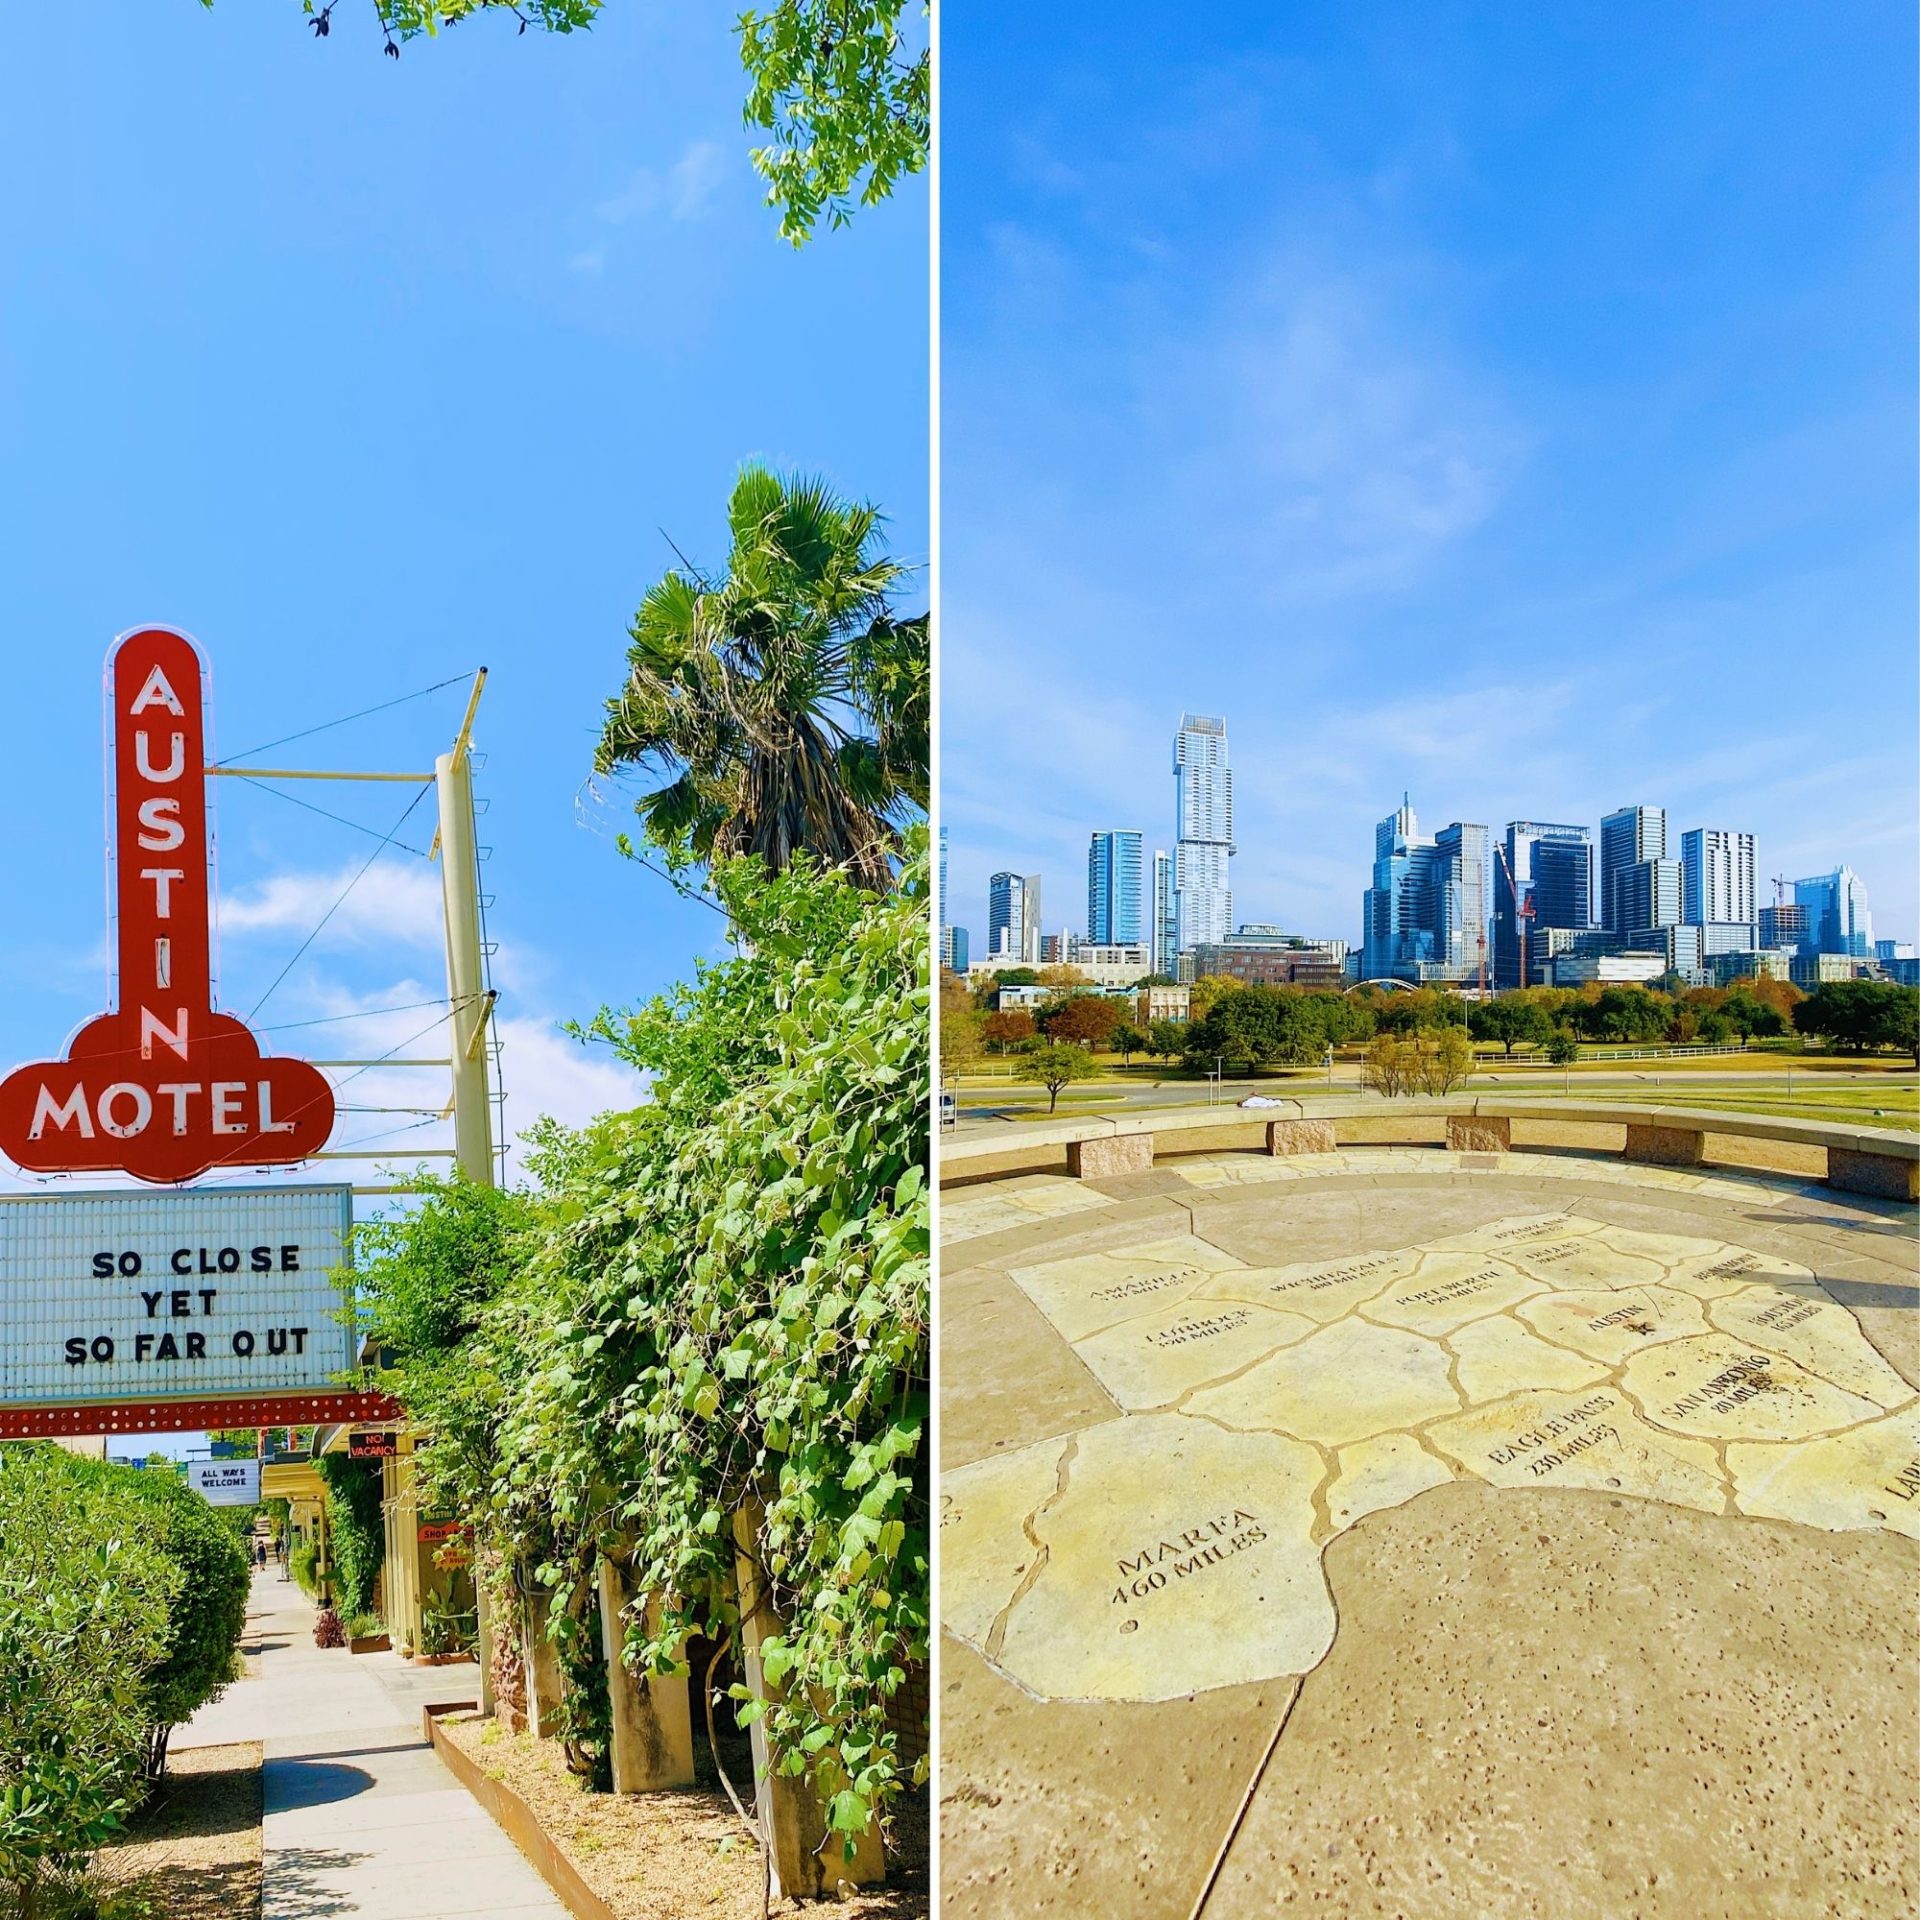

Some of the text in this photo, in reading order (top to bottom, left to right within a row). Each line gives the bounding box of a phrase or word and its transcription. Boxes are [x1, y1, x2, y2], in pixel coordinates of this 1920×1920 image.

[130, 664, 188, 1062] AUSTIN
[27, 1080, 297, 1142] MOTEL
[92, 1245, 300, 1279] SO CLOSE
[1269, 1257, 1400, 1292] WICHITA FALLS
[1090, 1269, 1198, 1299] AMARILLO
[1395, 1271, 1502, 1306] FORT WORTH
[140, 1289, 217, 1318] YET
[1588, 1305, 1647, 1332] AUSTIN
[1748, 1295, 1810, 1327] HOUSTON
[1145, 1308, 1253, 1343] LUBBOCK
[1190, 1318, 1249, 1340] MILES
[64, 1327, 309, 1365] SO FAR OUT
[1661, 1355, 1770, 1419] SAN ANTONIO
[366, 1434, 382, 1444] NO
[1488, 1396, 1615, 1465] EAGLE PASS
[351, 1445, 396, 1457] VACANCY
[1528, 1423, 1609, 1477] 230 MILES
[201, 1478, 247, 1487] WELCOME
[202, 1468, 246, 1478] ALL WAYS
[424, 1530, 447, 1538] SHOP
[1116, 1509, 1260, 1577] MARFA
[1112, 1525, 1268, 1604] 460 MILES
